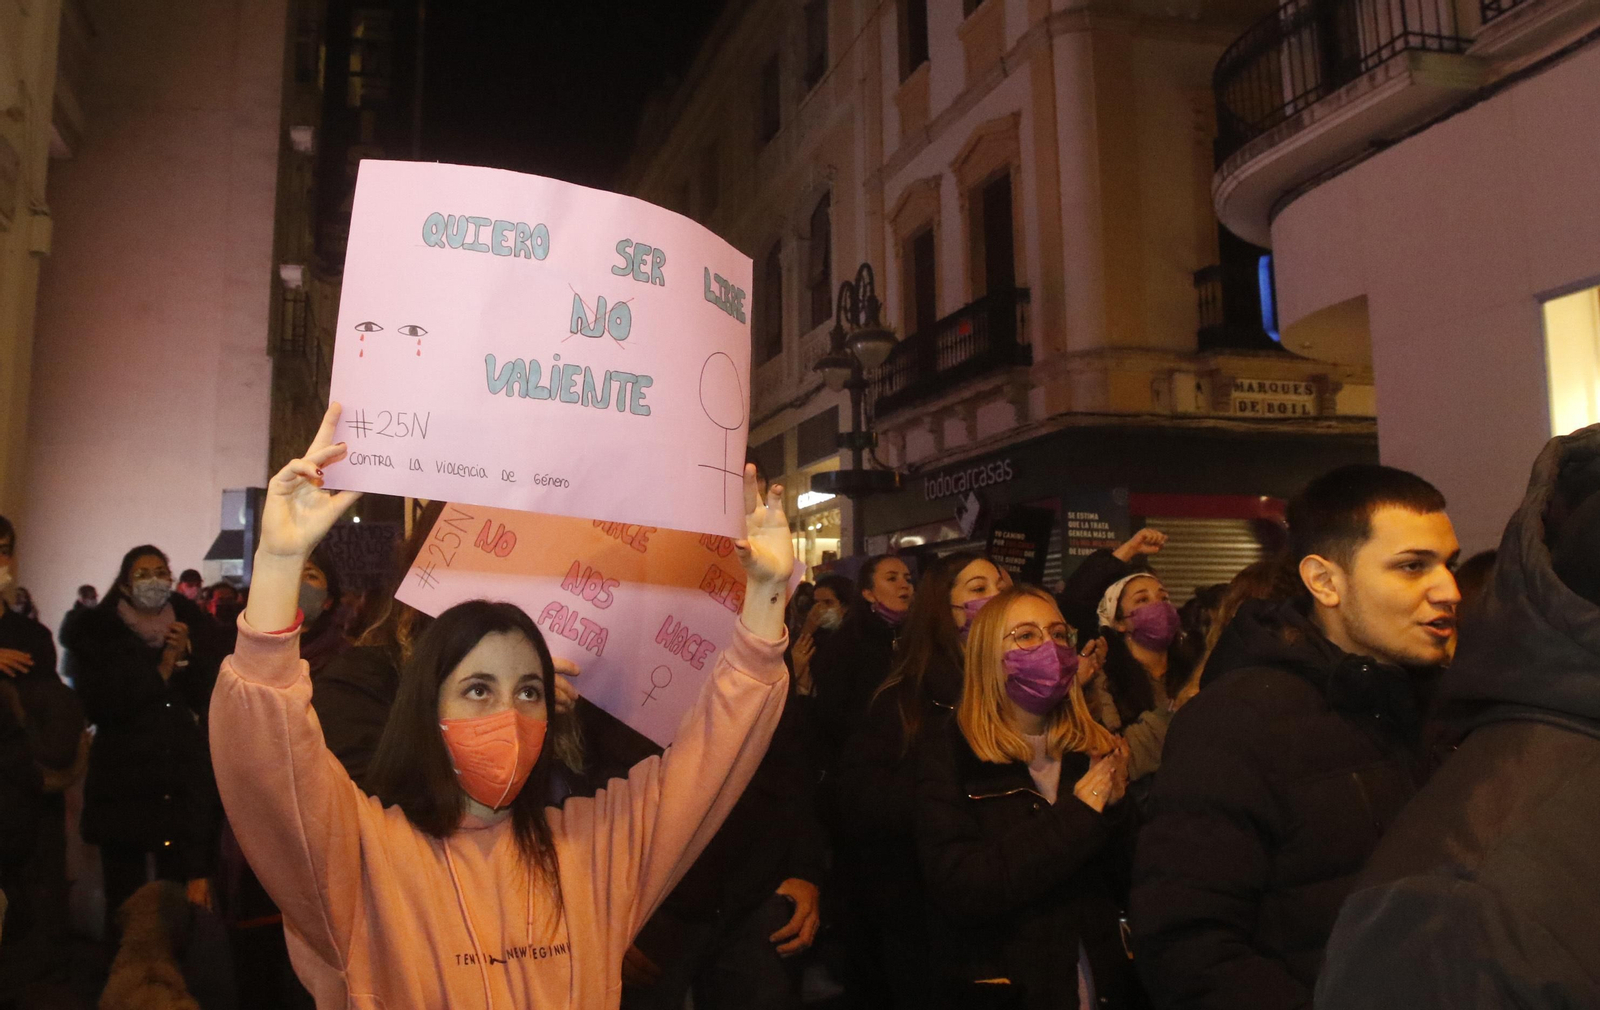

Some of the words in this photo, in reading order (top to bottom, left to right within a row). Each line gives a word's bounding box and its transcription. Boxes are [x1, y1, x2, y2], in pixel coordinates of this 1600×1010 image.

[422, 212, 550, 261] QUIERO
[611, 239, 667, 287] SER
[704, 266, 746, 324] LIBRE
[569, 293, 632, 341] NO
[485, 354, 653, 417] VALIENTE
[1234, 382, 1314, 395] MARQUES
[1238, 401, 1259, 412] DE
[345, 409, 430, 439] #25N
[924, 459, 1013, 500] todocarcasas
[414, 507, 475, 591] #25N
[1077, 548, 1097, 556] EURO
[473, 518, 518, 558] NO
[560, 559, 621, 609] NOS
[654, 614, 717, 671] HACE
[699, 563, 747, 615] BIE
[537, 600, 609, 657] FALTA
